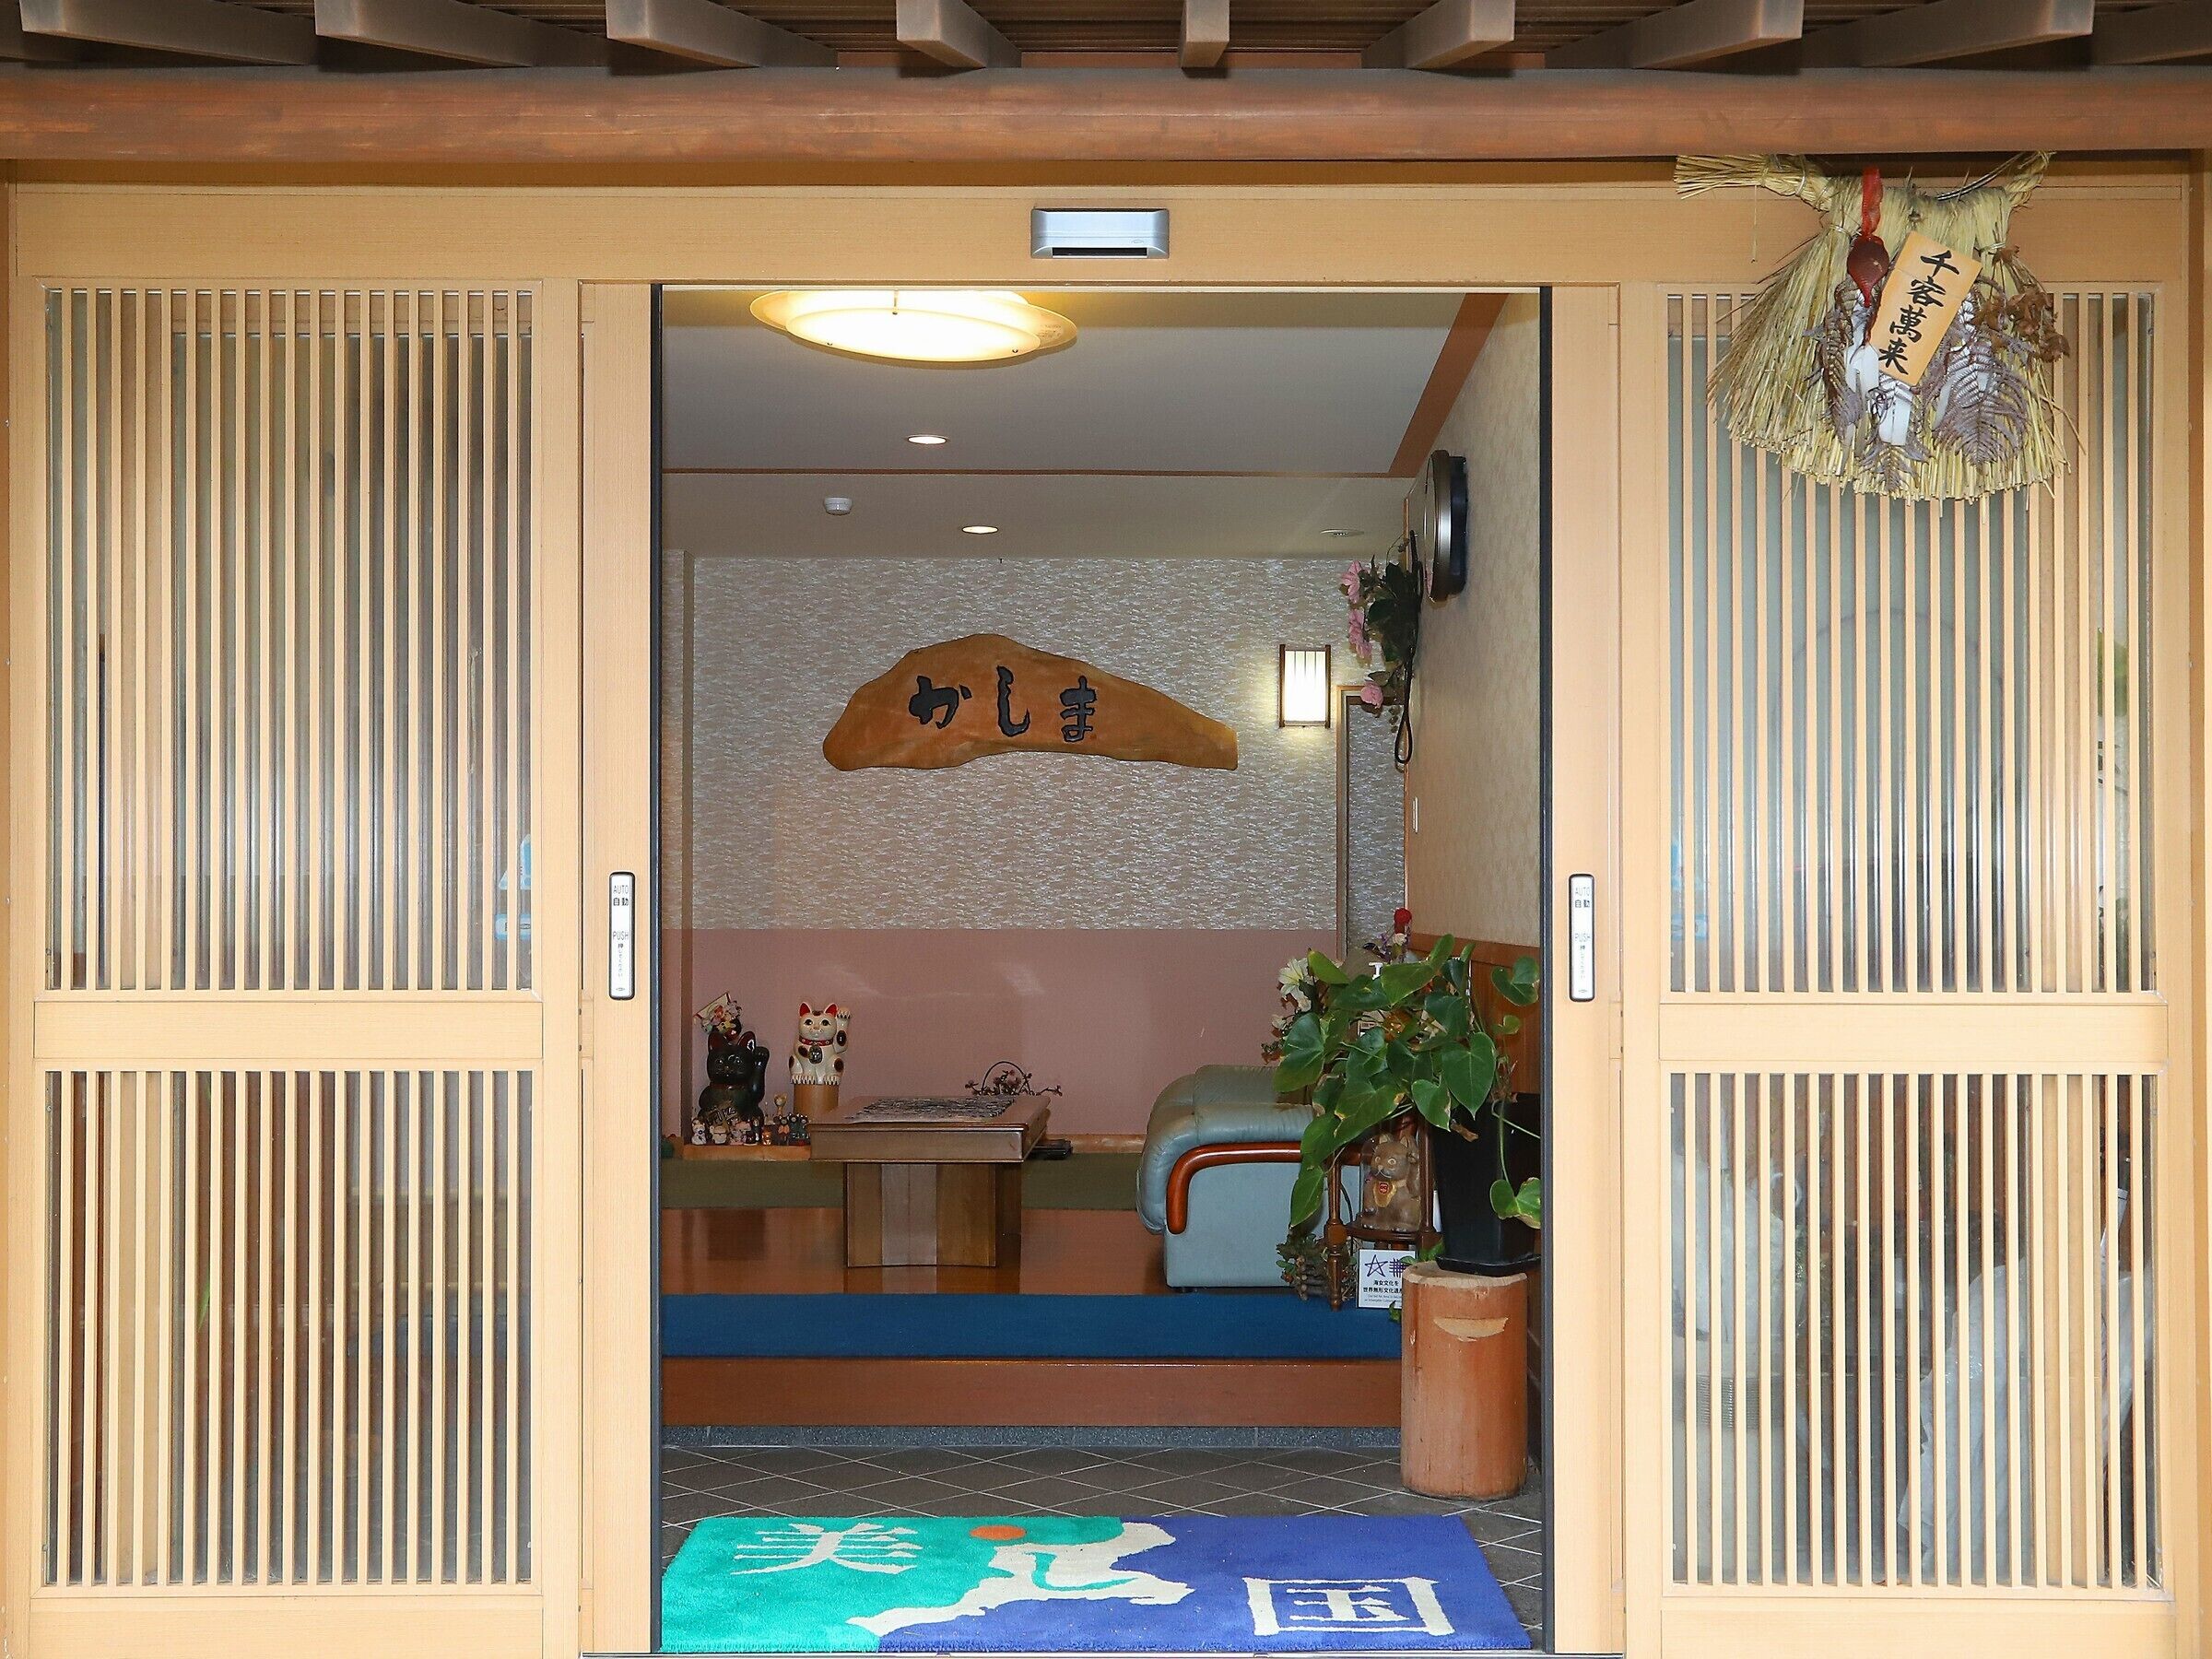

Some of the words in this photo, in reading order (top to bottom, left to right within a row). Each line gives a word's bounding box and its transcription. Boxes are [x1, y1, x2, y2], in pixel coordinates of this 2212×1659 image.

[1878, 250, 1960, 375] 千客萬来
[909, 665, 1098, 743] かしま
[613, 885, 629, 894] AUTO
[1575, 887, 1590, 896] AUTO
[613, 897, 629, 906] 自動
[1575, 900, 1590, 908] 自動
[613, 931, 629, 940] PUSH
[730, 1523, 924, 1574] 美
[1242, 1577, 1455, 1636] 国
